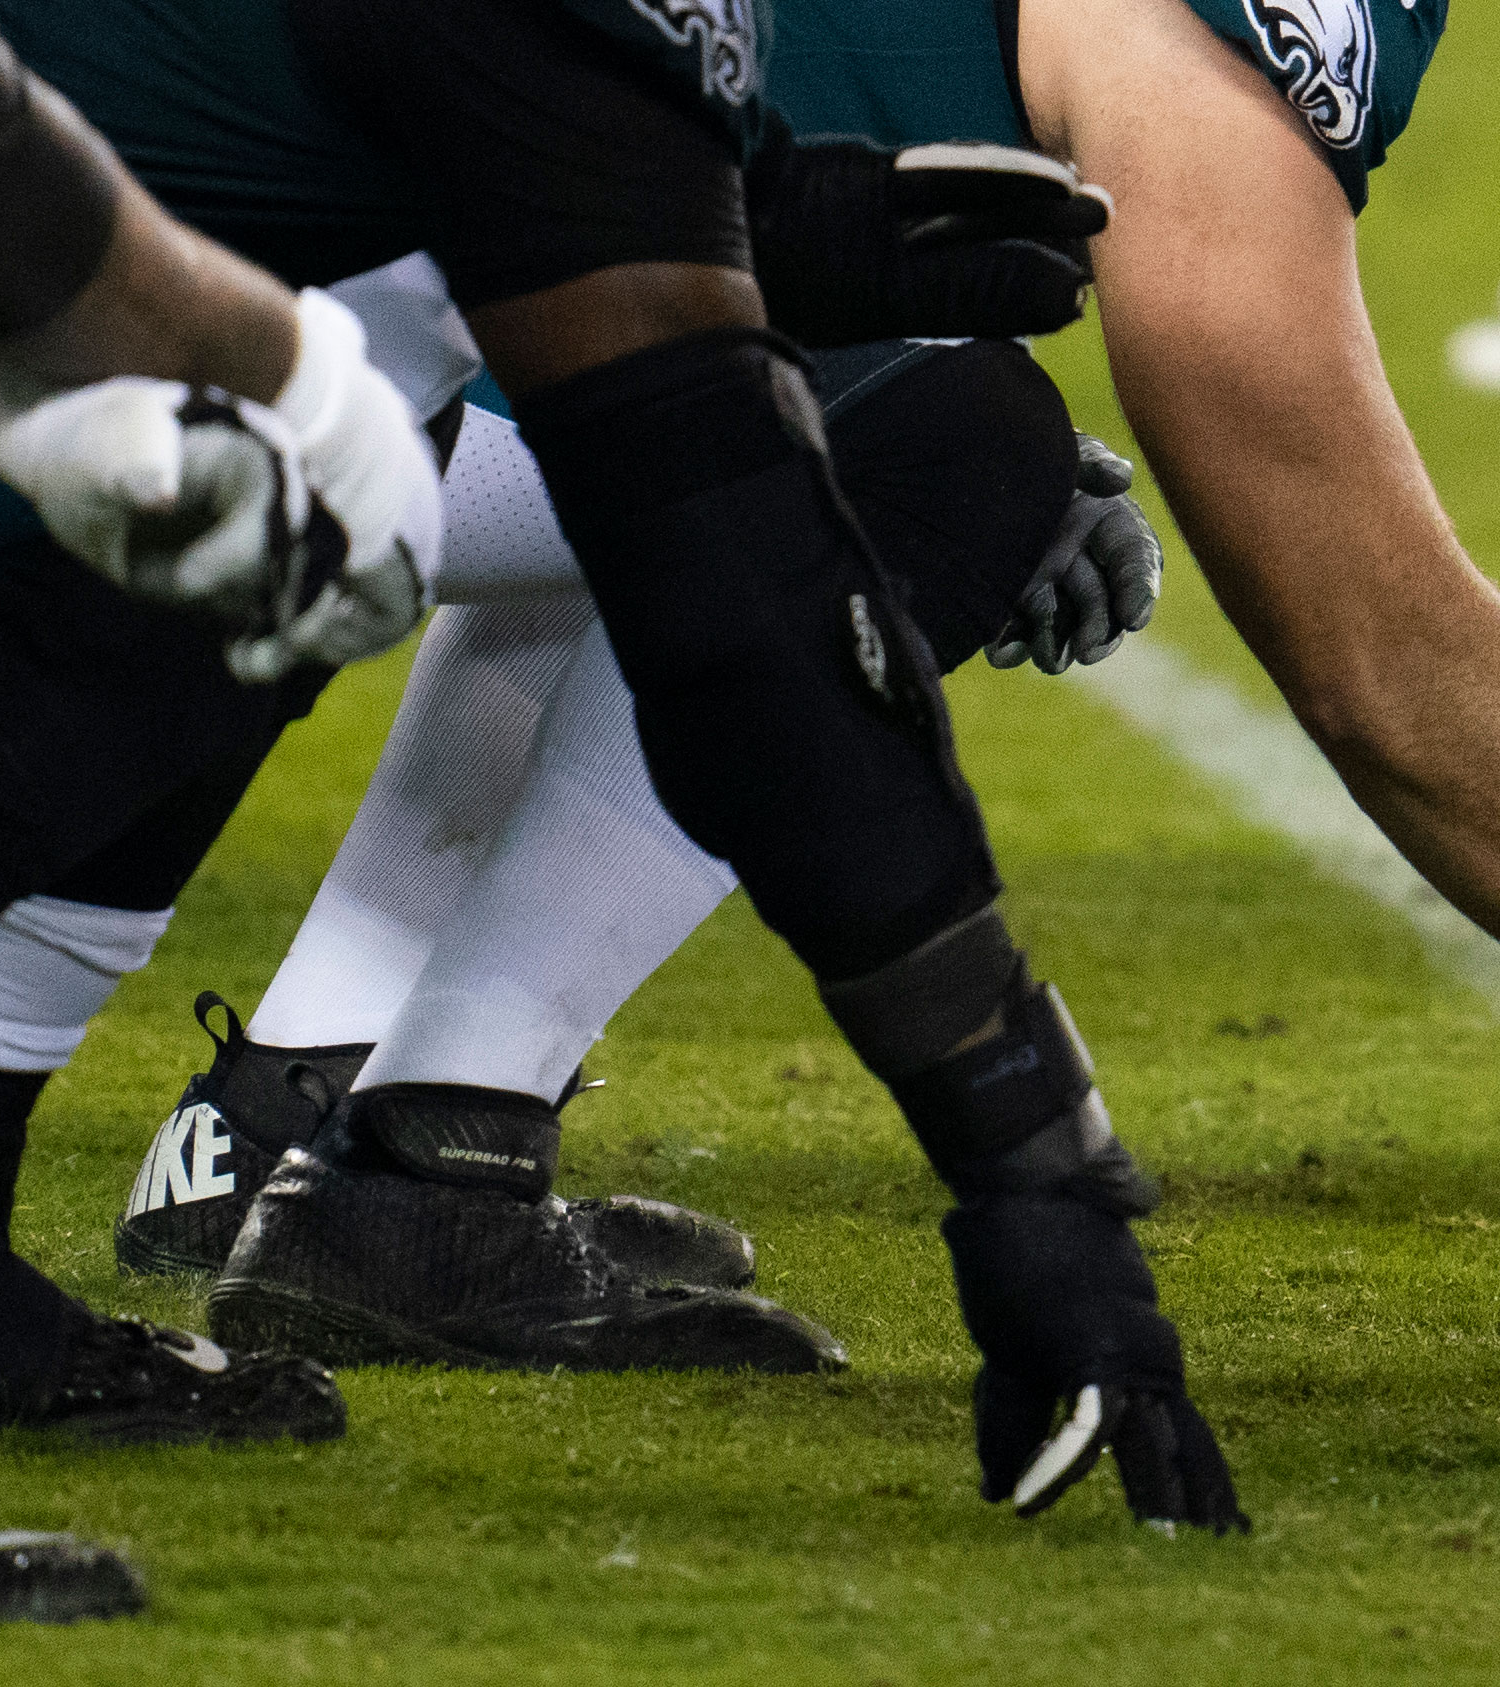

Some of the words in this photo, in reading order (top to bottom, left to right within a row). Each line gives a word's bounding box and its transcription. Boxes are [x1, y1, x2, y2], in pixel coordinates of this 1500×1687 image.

[125, 1102, 236, 1223] IKE
[437, 1146, 510, 1166] SUPERBAD
[511, 1156, 537, 1171] PRO
